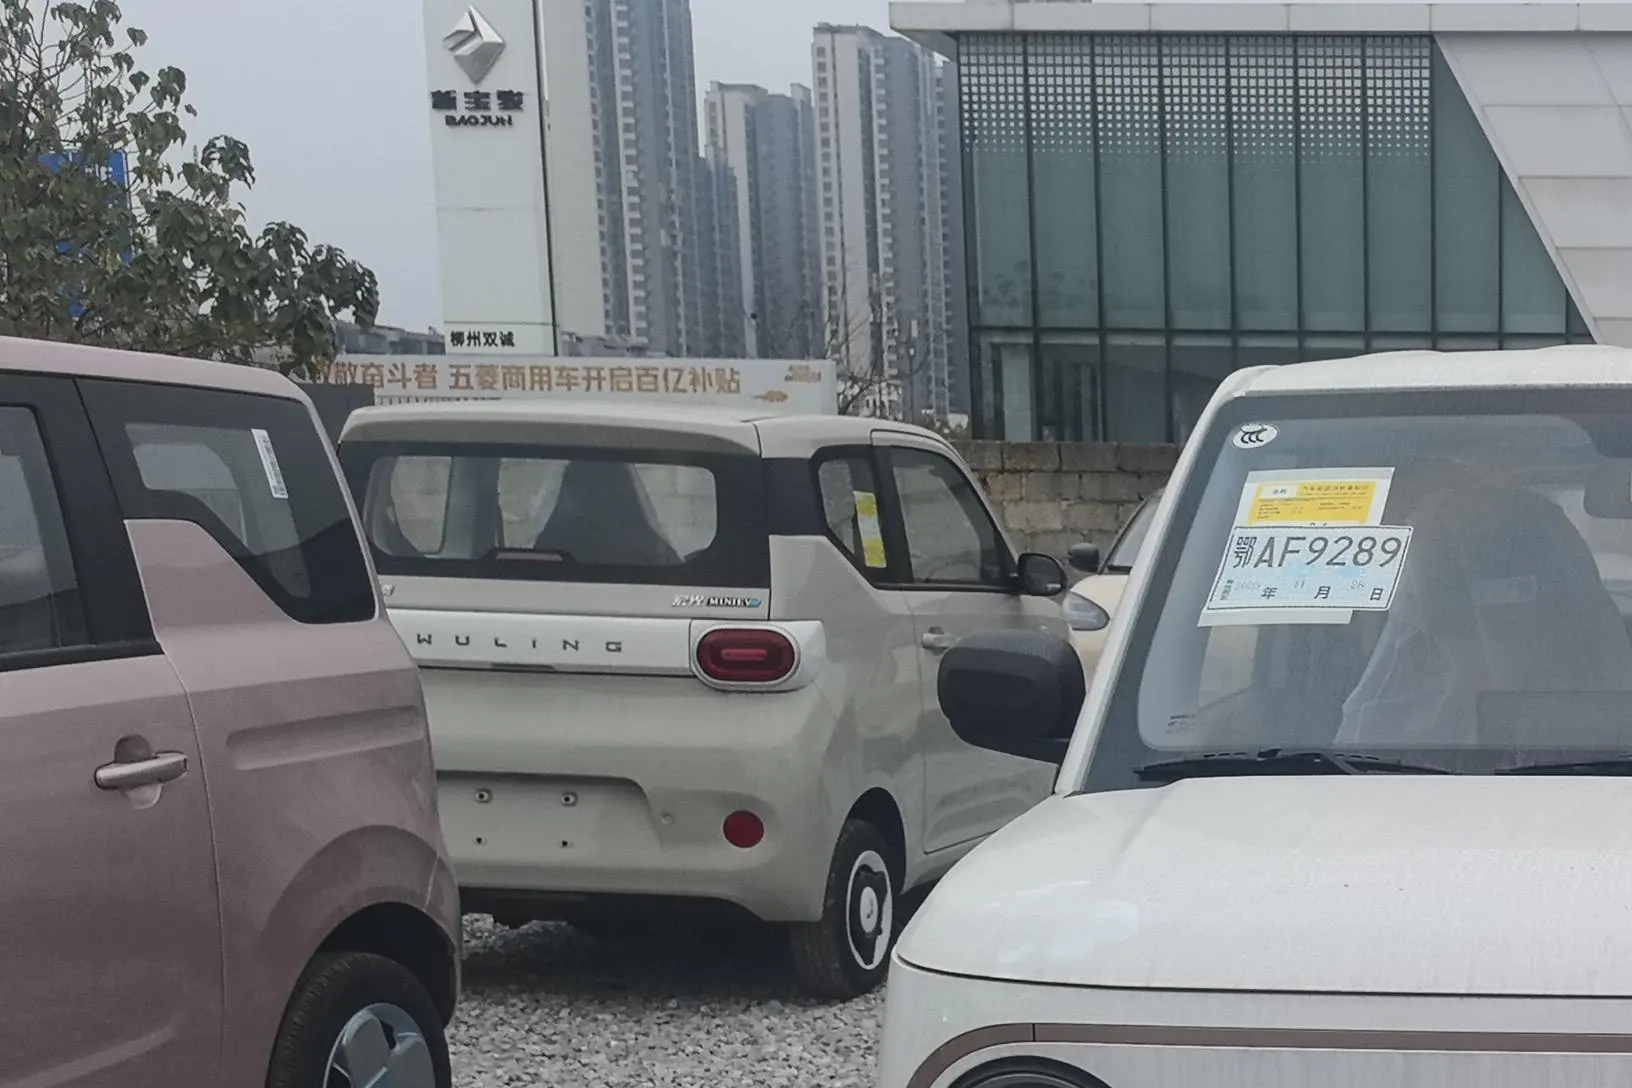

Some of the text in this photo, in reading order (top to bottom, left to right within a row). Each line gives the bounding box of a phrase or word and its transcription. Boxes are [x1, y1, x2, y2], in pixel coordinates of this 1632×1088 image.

[445, 114, 513, 127] BAOJUN
[450, 330, 515, 348] 柳州双诚
[448, 363, 741, 394] 五菱商用车开启百亿补贴
[1233, 536, 1401, 568] 鄂AF9289
[1261, 585, 1384, 601] 年 月 日
[417, 633, 623, 653] WULING
